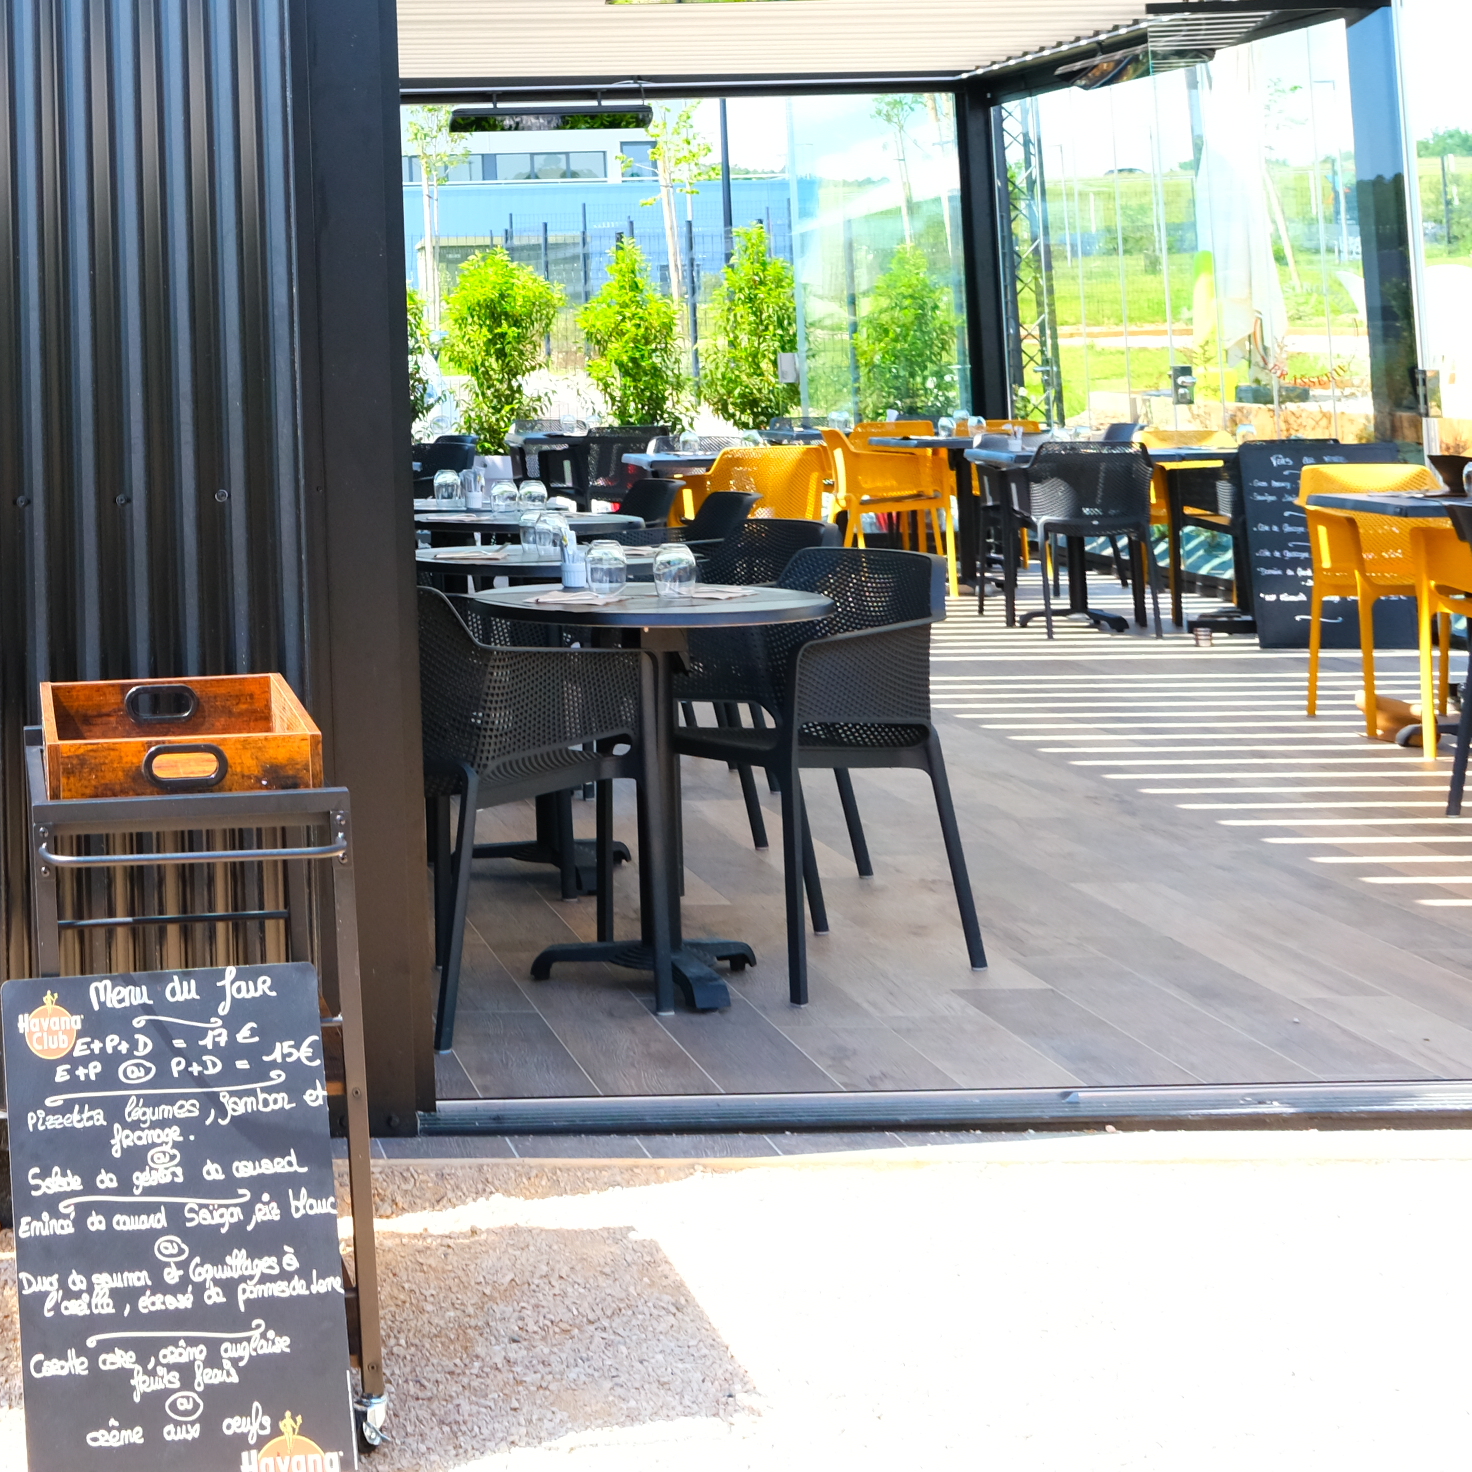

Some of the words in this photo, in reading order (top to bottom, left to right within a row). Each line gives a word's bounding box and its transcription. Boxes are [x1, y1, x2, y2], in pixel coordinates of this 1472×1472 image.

[89, 979, 154, 1011] Menu
[164, 975, 201, 1002] du
[18, 1013, 82, 1034] Havana
[32, 1030, 69, 1050] Club
[262, 1035, 321, 1067] 15€
[27, 1104, 107, 1132] Pizzetta
[303, 1079, 328, 1106] et
[28, 1166, 83, 1196] Salade
[96, 1168, 118, 1189] de
[202, 1159, 225, 1180] de
[87, 1210, 106, 1231] de
[288, 1186, 338, 1218] blanc
[68, 1269, 87, 1291] de
[91, 1270, 152, 1288] saumon
[163, 1261, 184, 1284] et
[282, 1244, 300, 1272] à
[203, 1280, 226, 1305] de
[162, 1423, 200, 1441] aux
[240, 1449, 341, 1472] Havana
